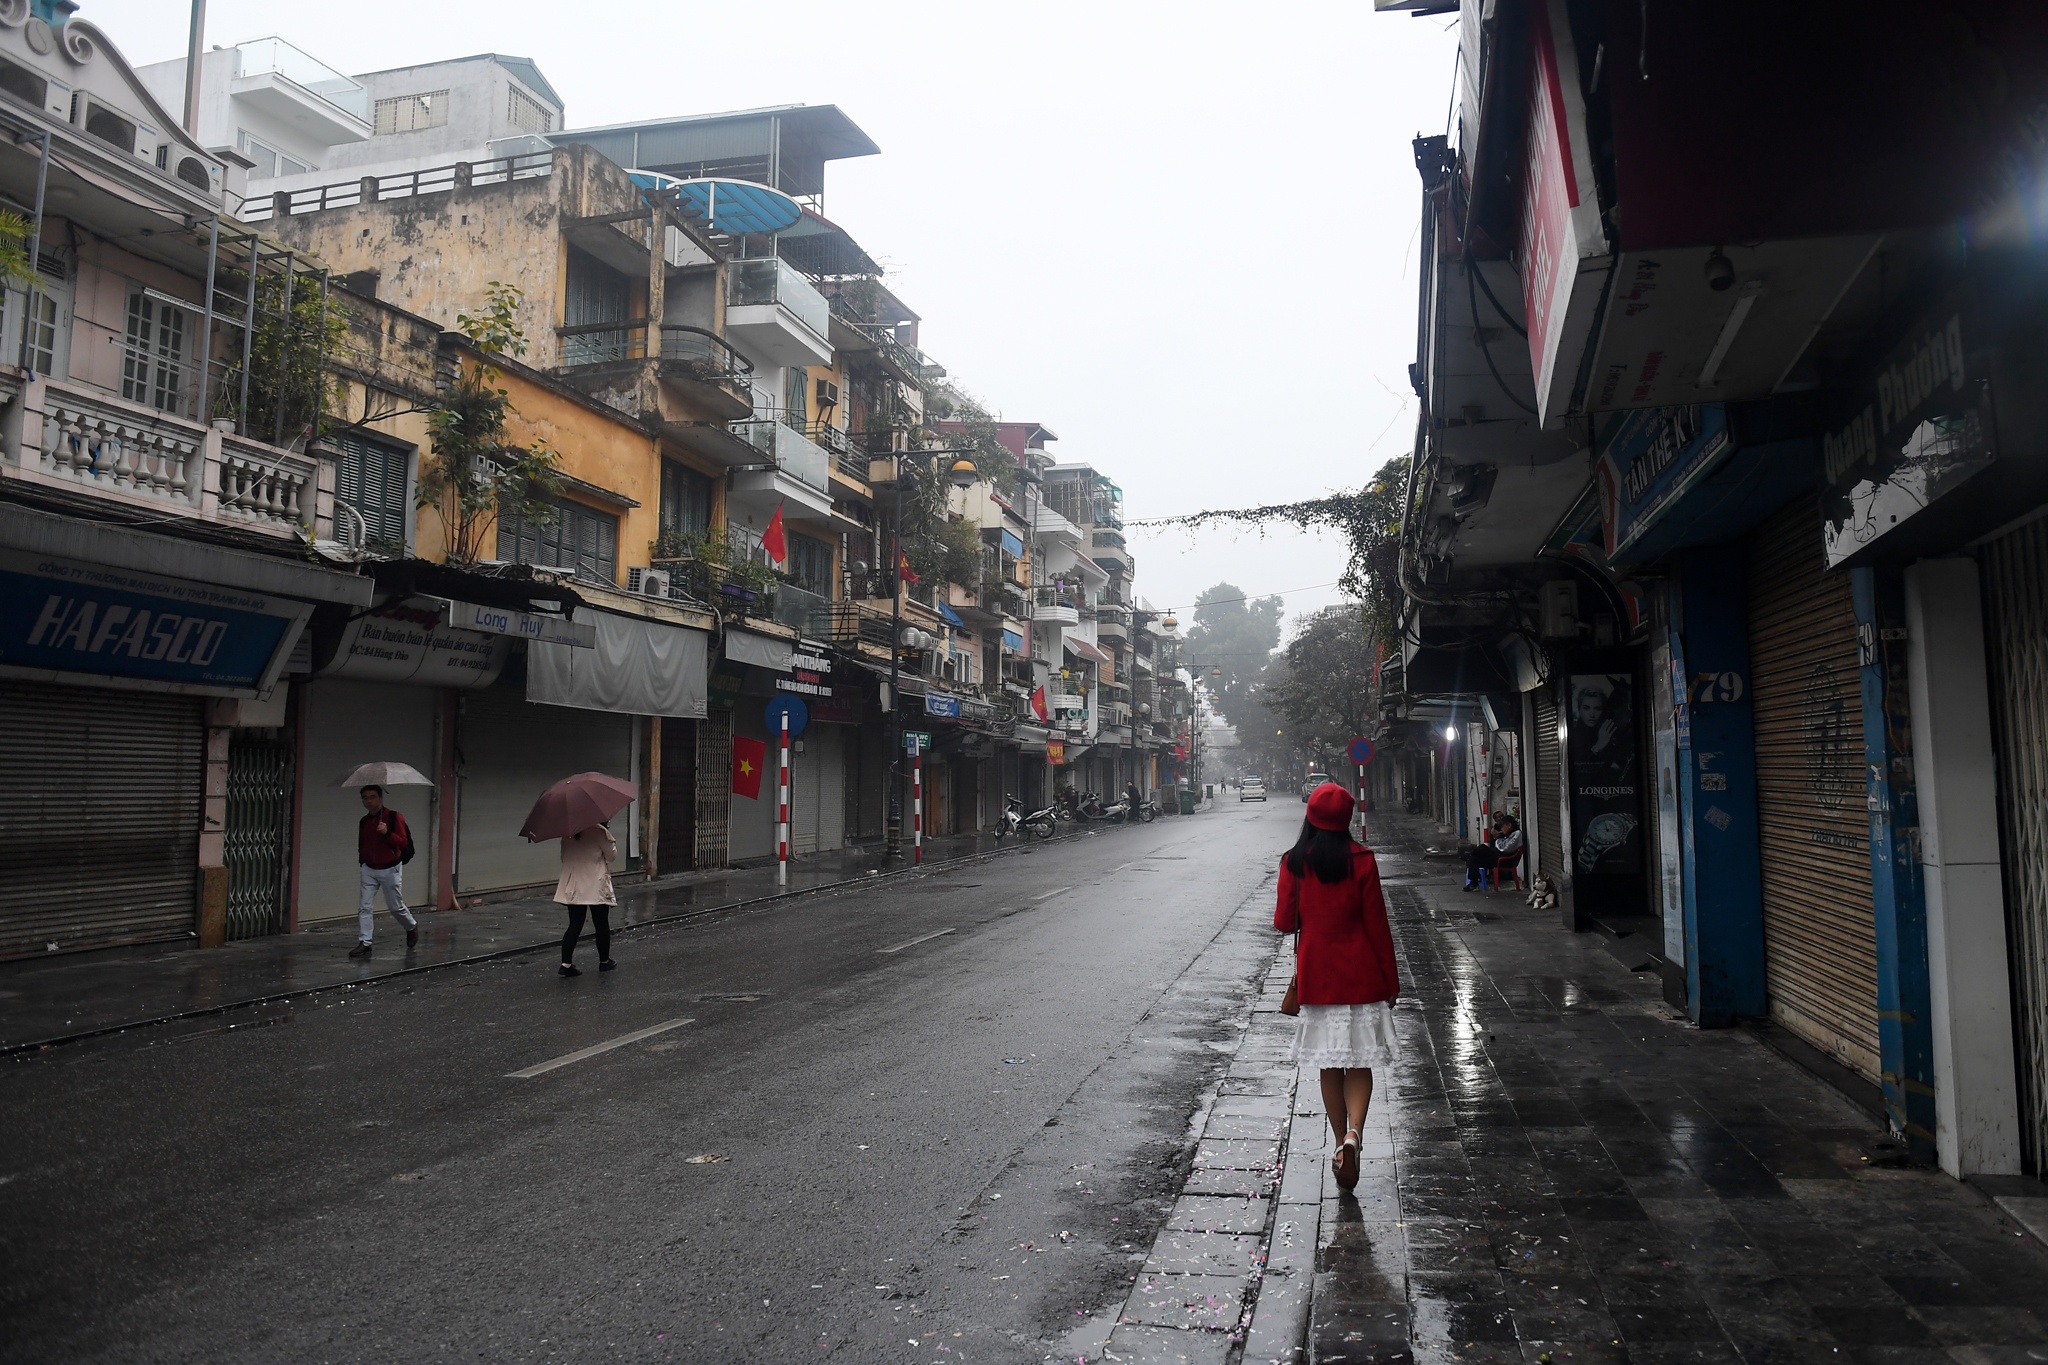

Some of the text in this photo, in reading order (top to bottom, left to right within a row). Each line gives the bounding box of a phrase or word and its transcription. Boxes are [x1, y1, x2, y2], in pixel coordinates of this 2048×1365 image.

[1824, 402, 1877, 485] Quang
[1624, 455, 1650, 503] TÂN
[37, 562, 69, 575] CÔNG
[71, 568, 84, 577] TY
[209, 592, 239, 605] TRANG
[26, 594, 229, 666] HAFASCO
[362, 623, 382, 640] Bán
[406, 630, 423, 647] bán
[454, 637, 464, 651] áo
[464, 642, 479, 653] cao
[475, 607, 544, 637] Long Huy
[1698, 671, 1744, 703] 79
[1579, 786, 1634, 796] LONGINES
